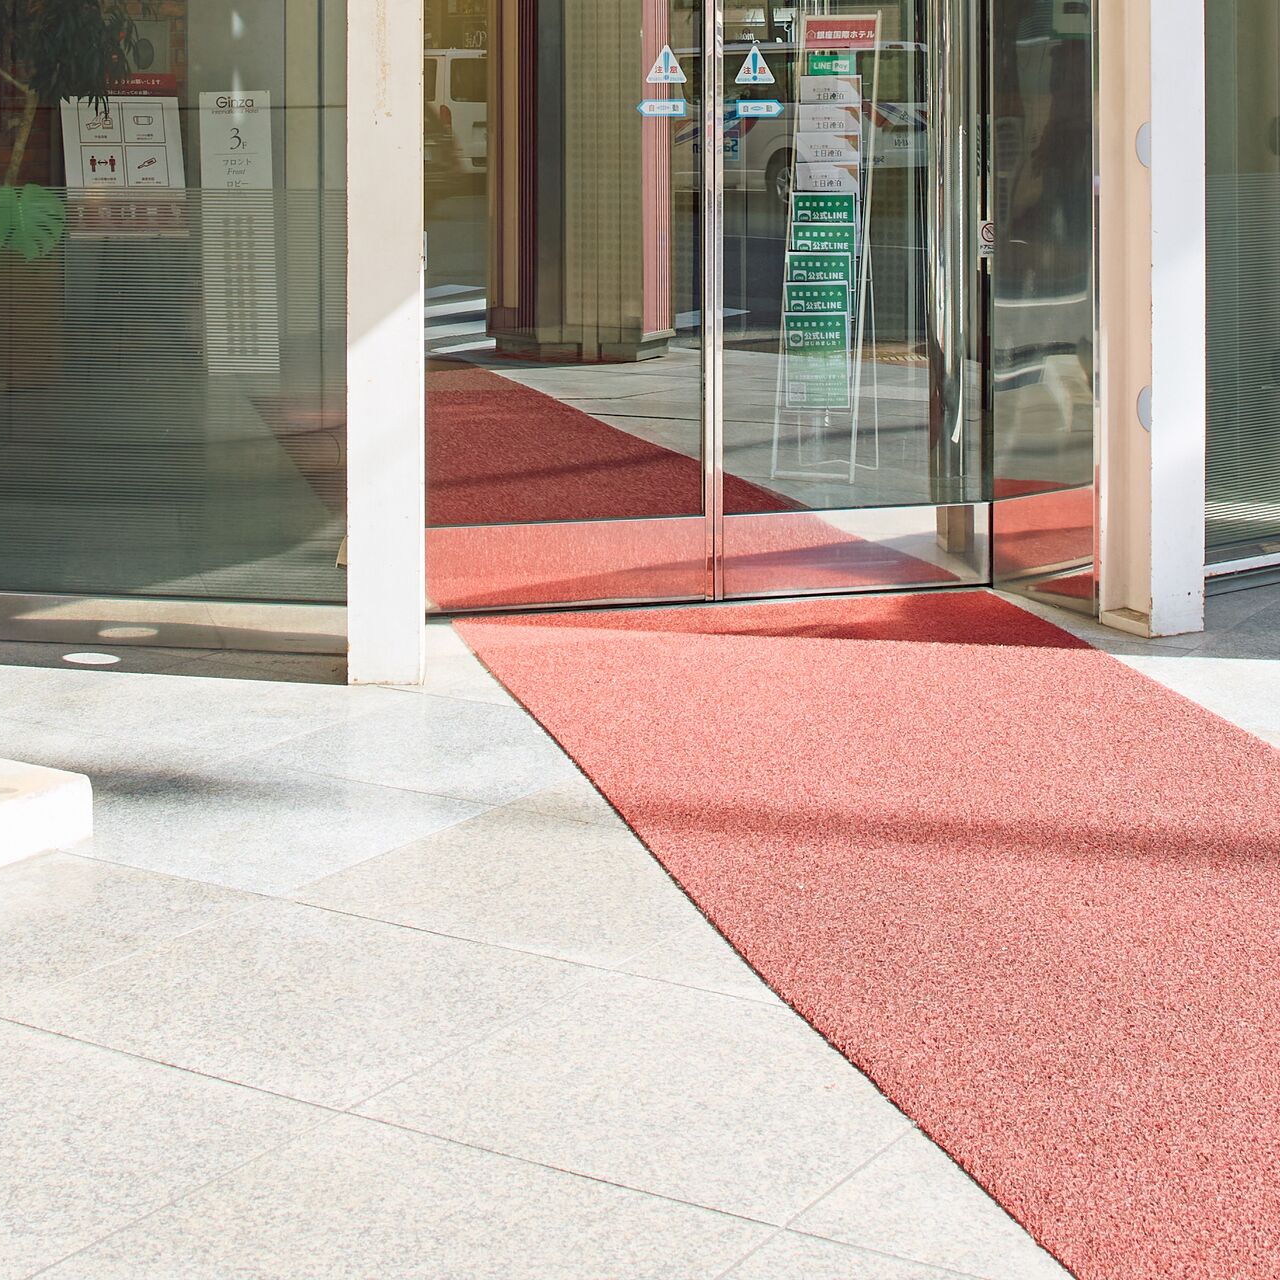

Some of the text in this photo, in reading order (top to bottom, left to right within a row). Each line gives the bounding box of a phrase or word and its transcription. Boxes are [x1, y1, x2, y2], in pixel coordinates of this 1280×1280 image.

[816, 30, 875, 39] 銀座国際ホテル
[813, 62, 848, 71] LINE Pay
[216, 96, 254, 109] Ginza
[230, 127, 248, 150] 3F
[222, 158, 252, 166] フロント
[227, 167, 246, 175] Front
[227, 180, 249, 188] ロビー
[812, 211, 848, 219] 公式LINE
[813, 241, 849, 250] 公式LINE
[808, 271, 844, 280] 公式LINE
[806, 301, 842, 309] 公式LINE
[804, 331, 841, 340] 公式LINE
